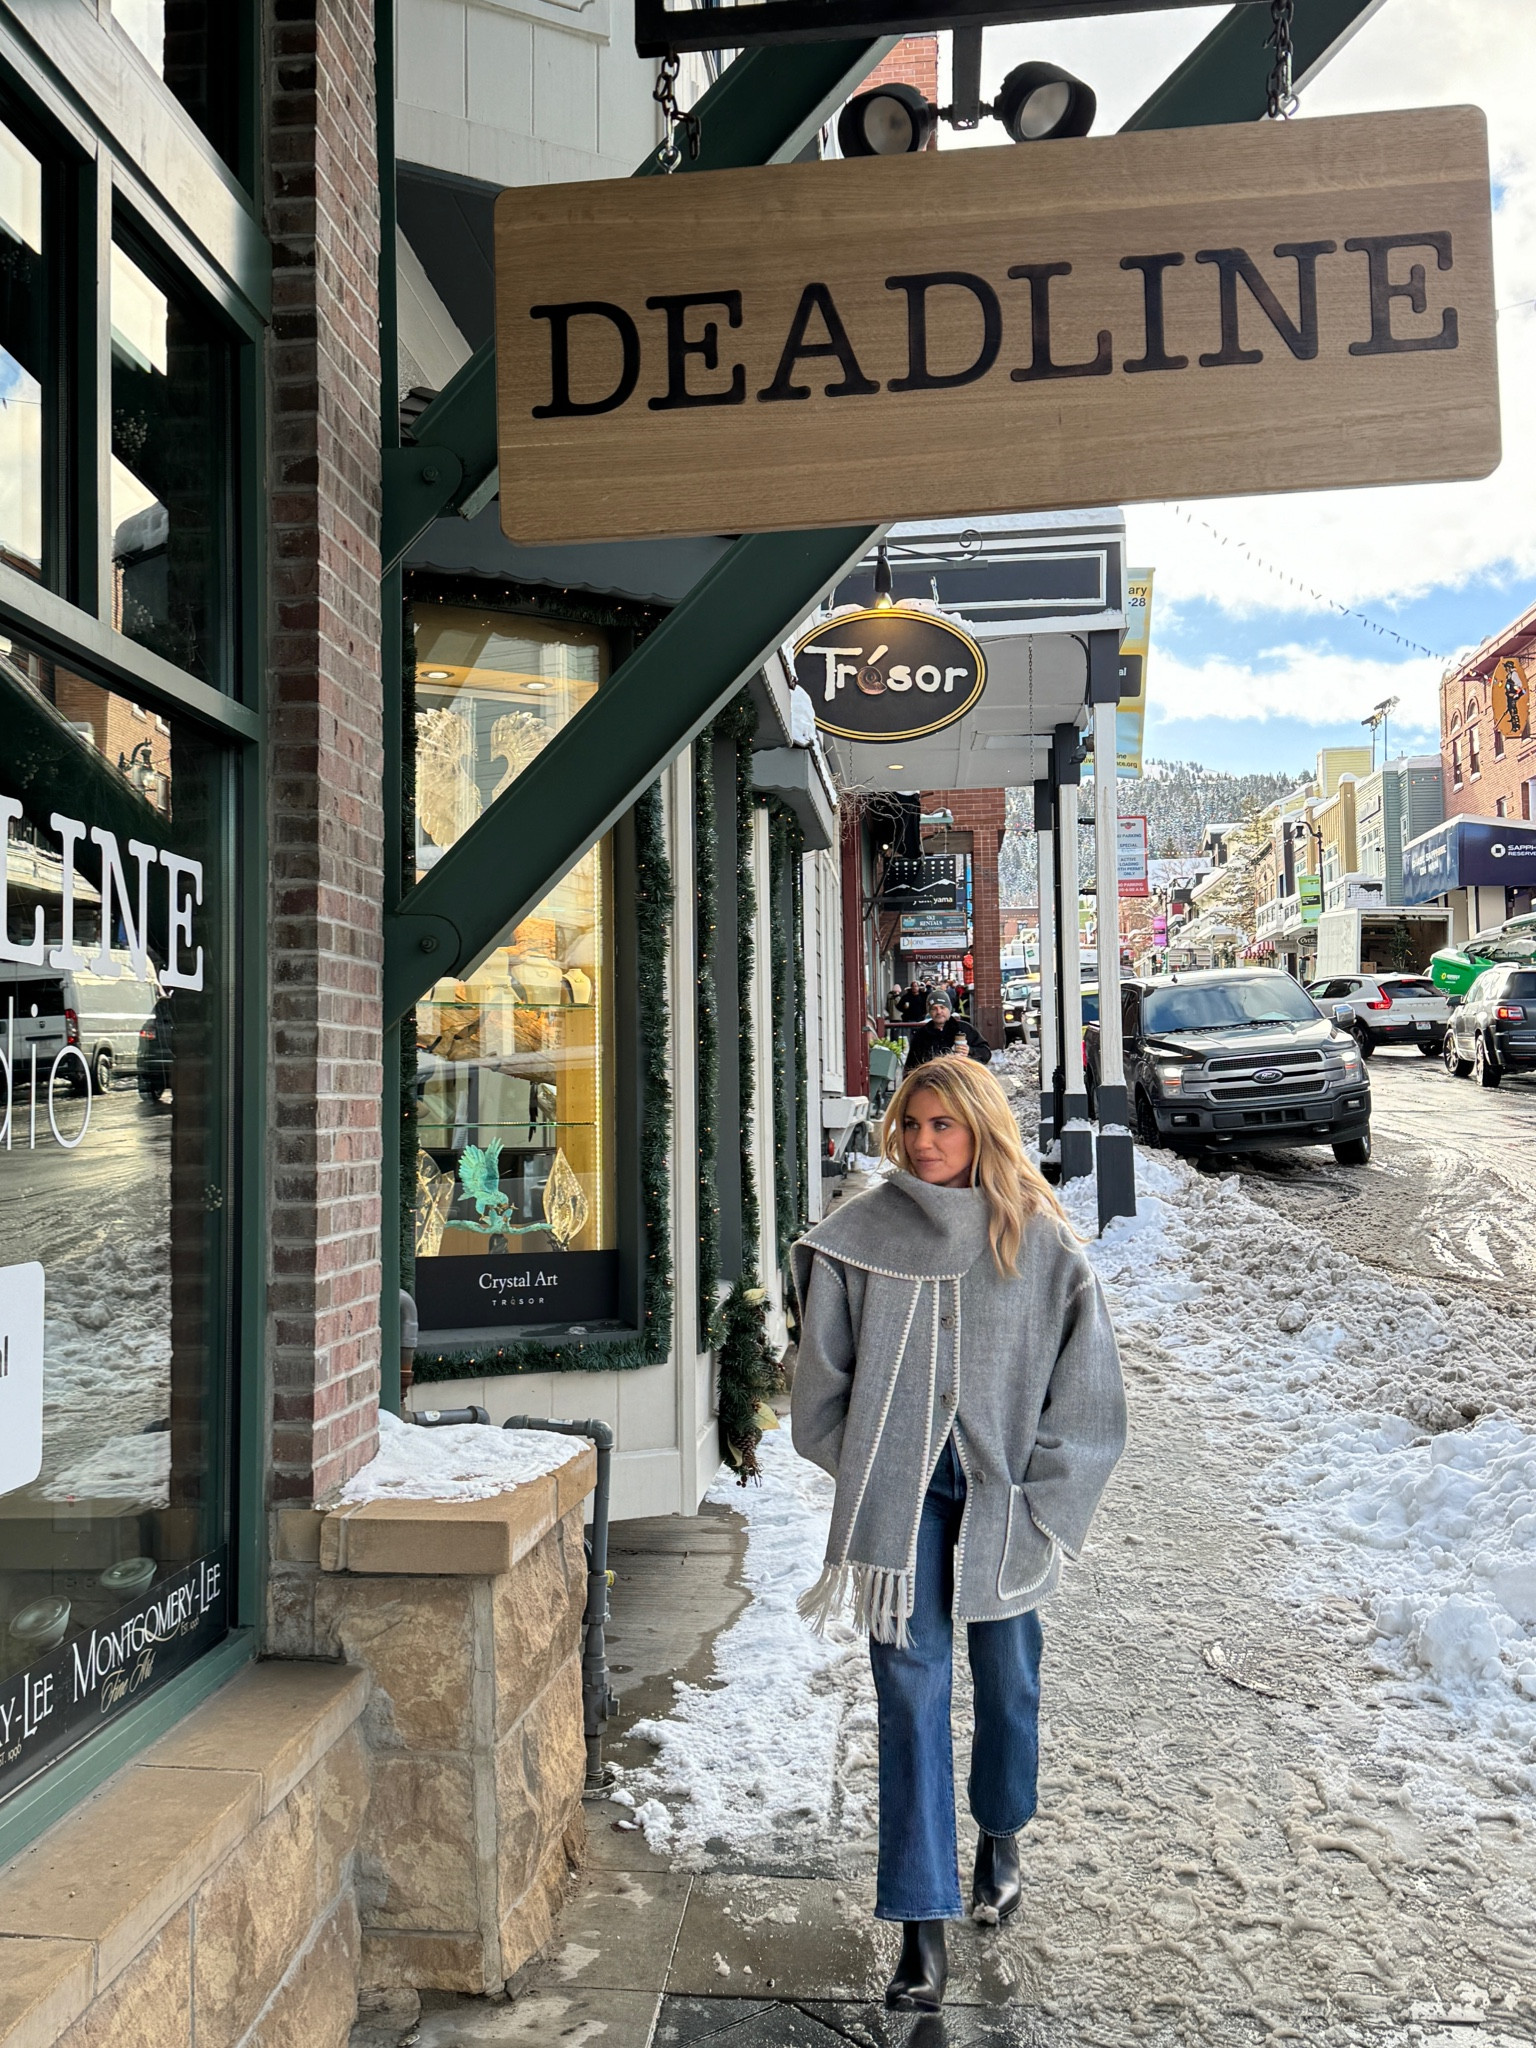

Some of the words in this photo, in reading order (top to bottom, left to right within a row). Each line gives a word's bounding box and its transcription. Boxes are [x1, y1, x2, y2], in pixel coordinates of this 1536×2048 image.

[530, 229, 1459, 420] DEADLINE
[803, 644, 969, 702] Trésor
[0, 793, 204, 992] LINE
[478, 1270, 531, 1294] Crystal
[534, 1270, 559, 1287] Art
